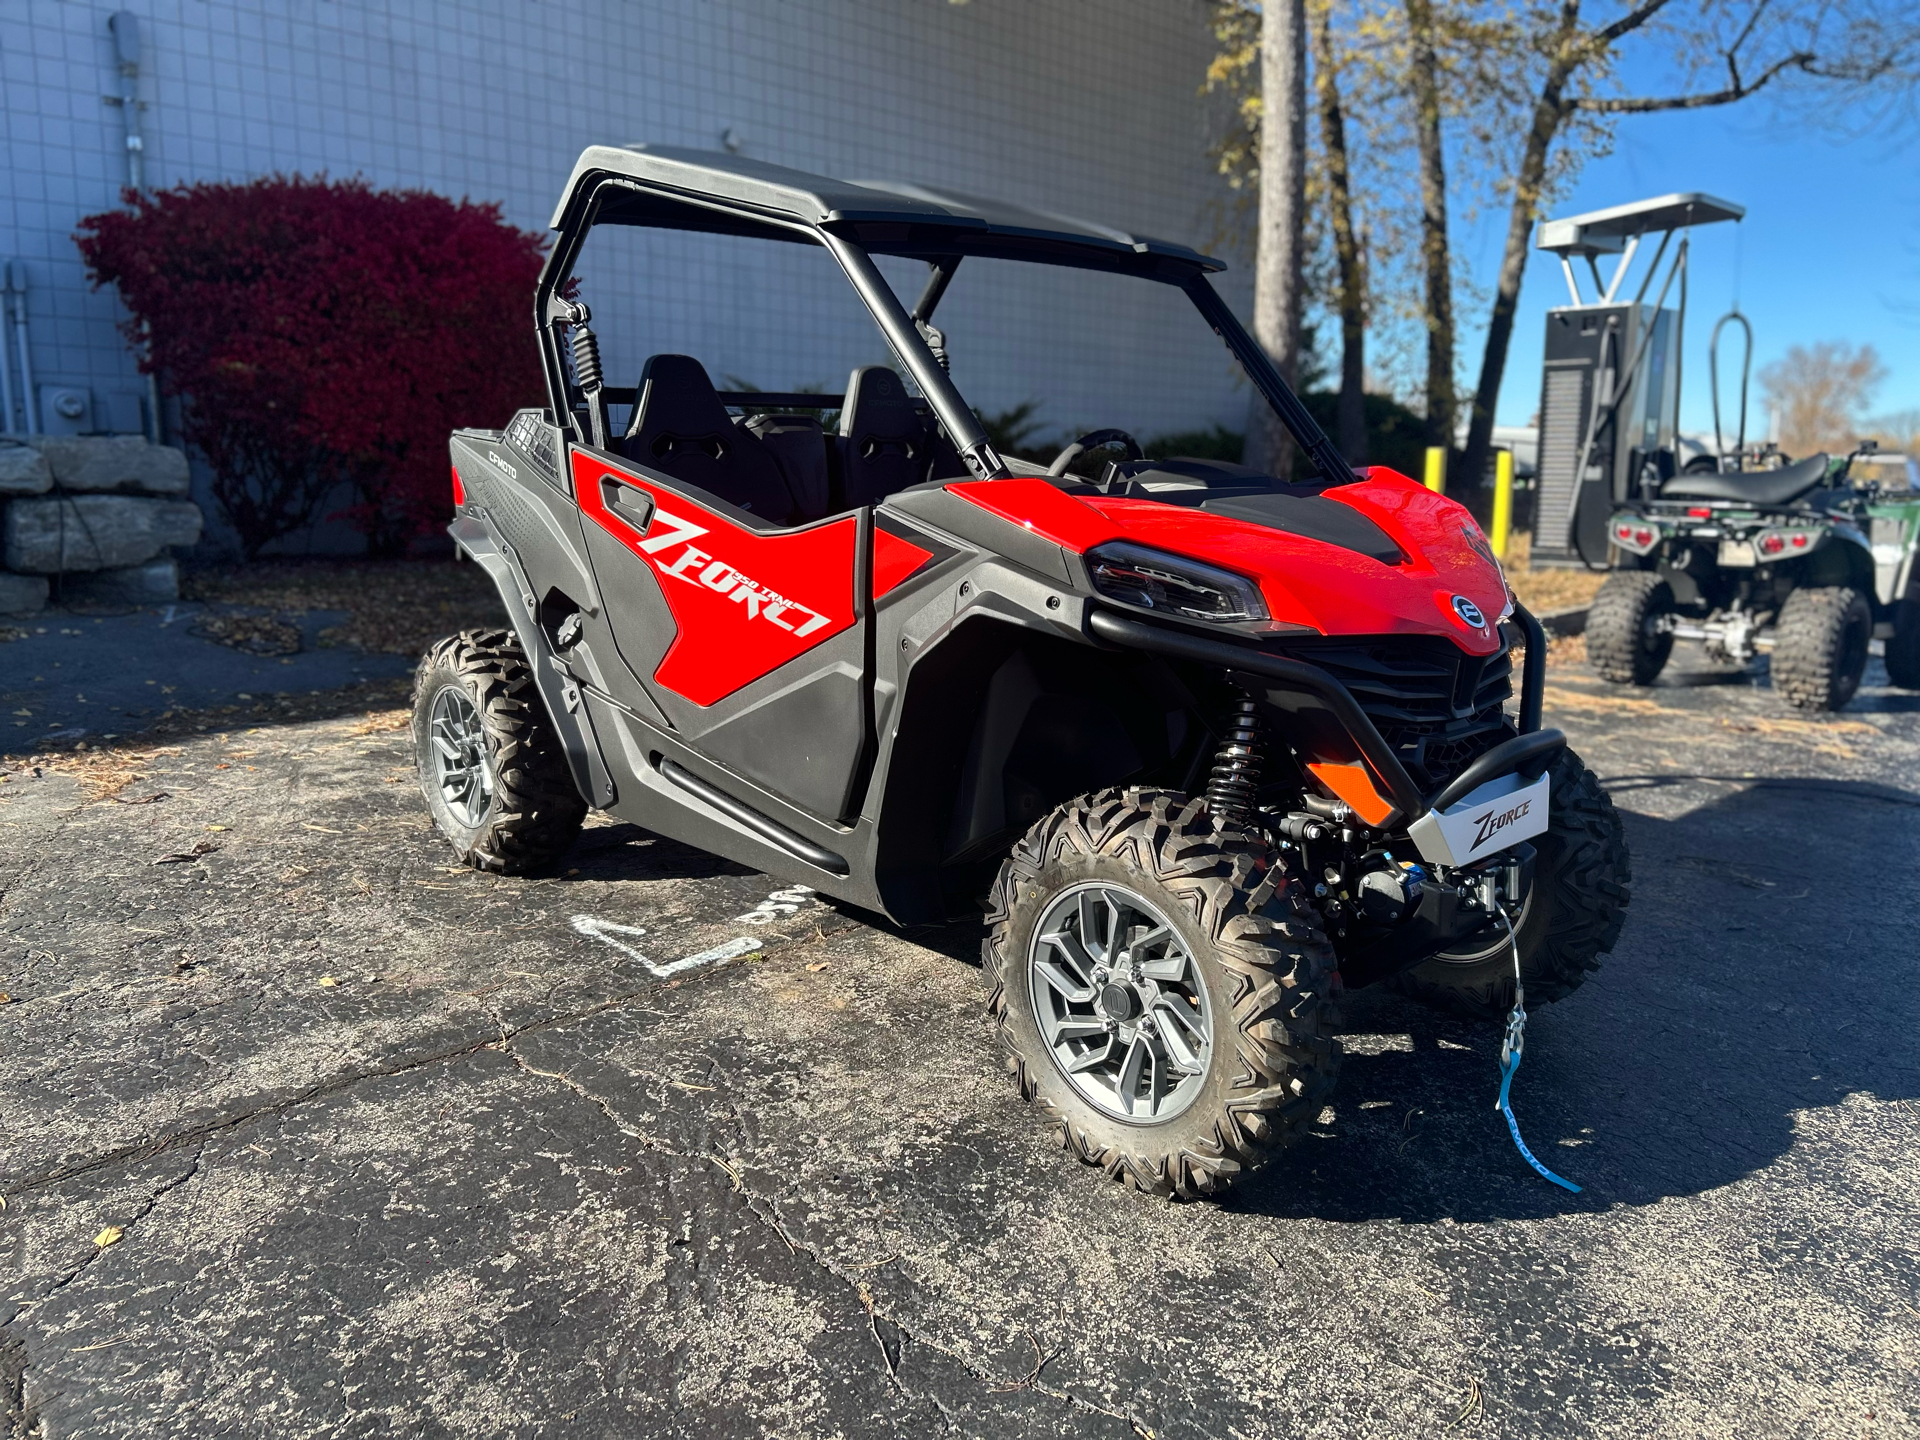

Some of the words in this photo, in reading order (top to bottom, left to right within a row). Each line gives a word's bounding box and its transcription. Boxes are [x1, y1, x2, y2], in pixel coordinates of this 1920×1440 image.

[488, 450, 517, 479] CFMOTO
[732, 571, 760, 590] 950
[760, 585, 796, 610] TRAIL
[1468, 799, 1533, 853] ZFORCE
[1503, 1105, 1550, 1176] CFMOTO
